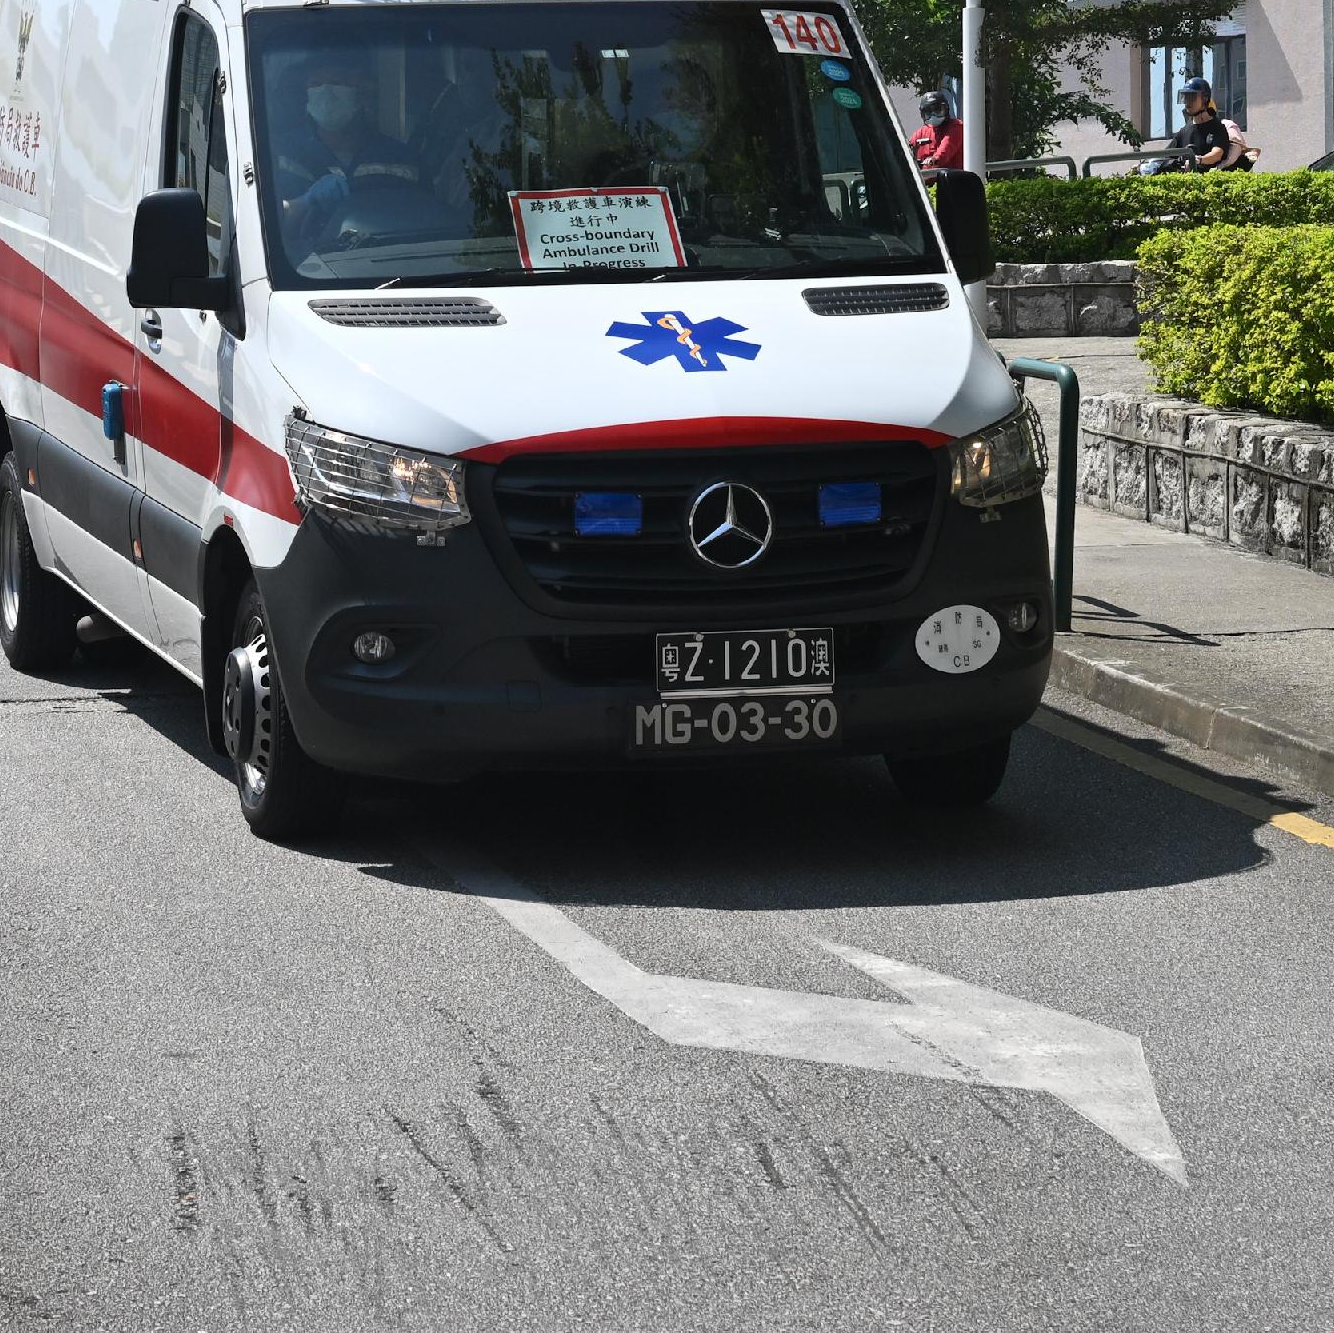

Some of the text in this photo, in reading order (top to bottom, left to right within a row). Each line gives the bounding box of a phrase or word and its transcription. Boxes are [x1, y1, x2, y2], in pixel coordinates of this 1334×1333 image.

[772, 13, 842, 54] 140
[530, 195, 653, 214] 跨境救護車演練
[569, 213, 619, 228] 進行中
[540, 227, 655, 245] Cross-boundary
[542, 241, 660, 259] Ambulance Drill
[634, 698, 838, 746] MG-03-30
